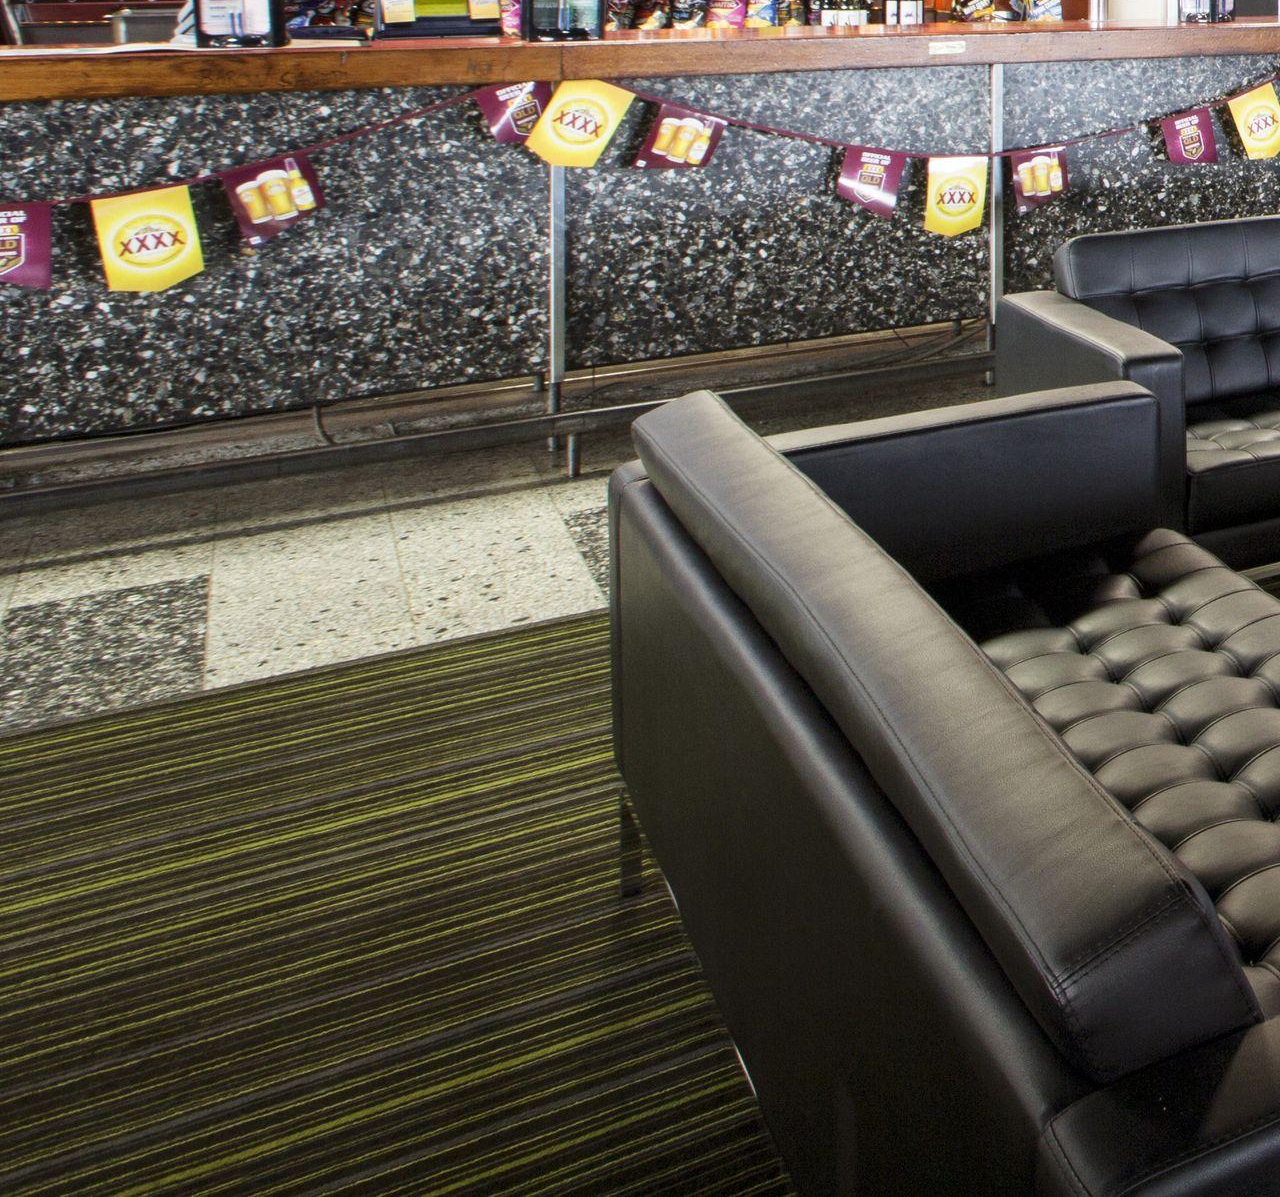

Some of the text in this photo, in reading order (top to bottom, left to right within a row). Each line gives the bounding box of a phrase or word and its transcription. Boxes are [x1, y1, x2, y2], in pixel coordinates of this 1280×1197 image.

[552, 111, 602, 138] XXXX
[1247, 114, 1279, 136] XXXX
[937, 191, 976, 205] XXXX
[119, 231, 186, 257] XXXX
